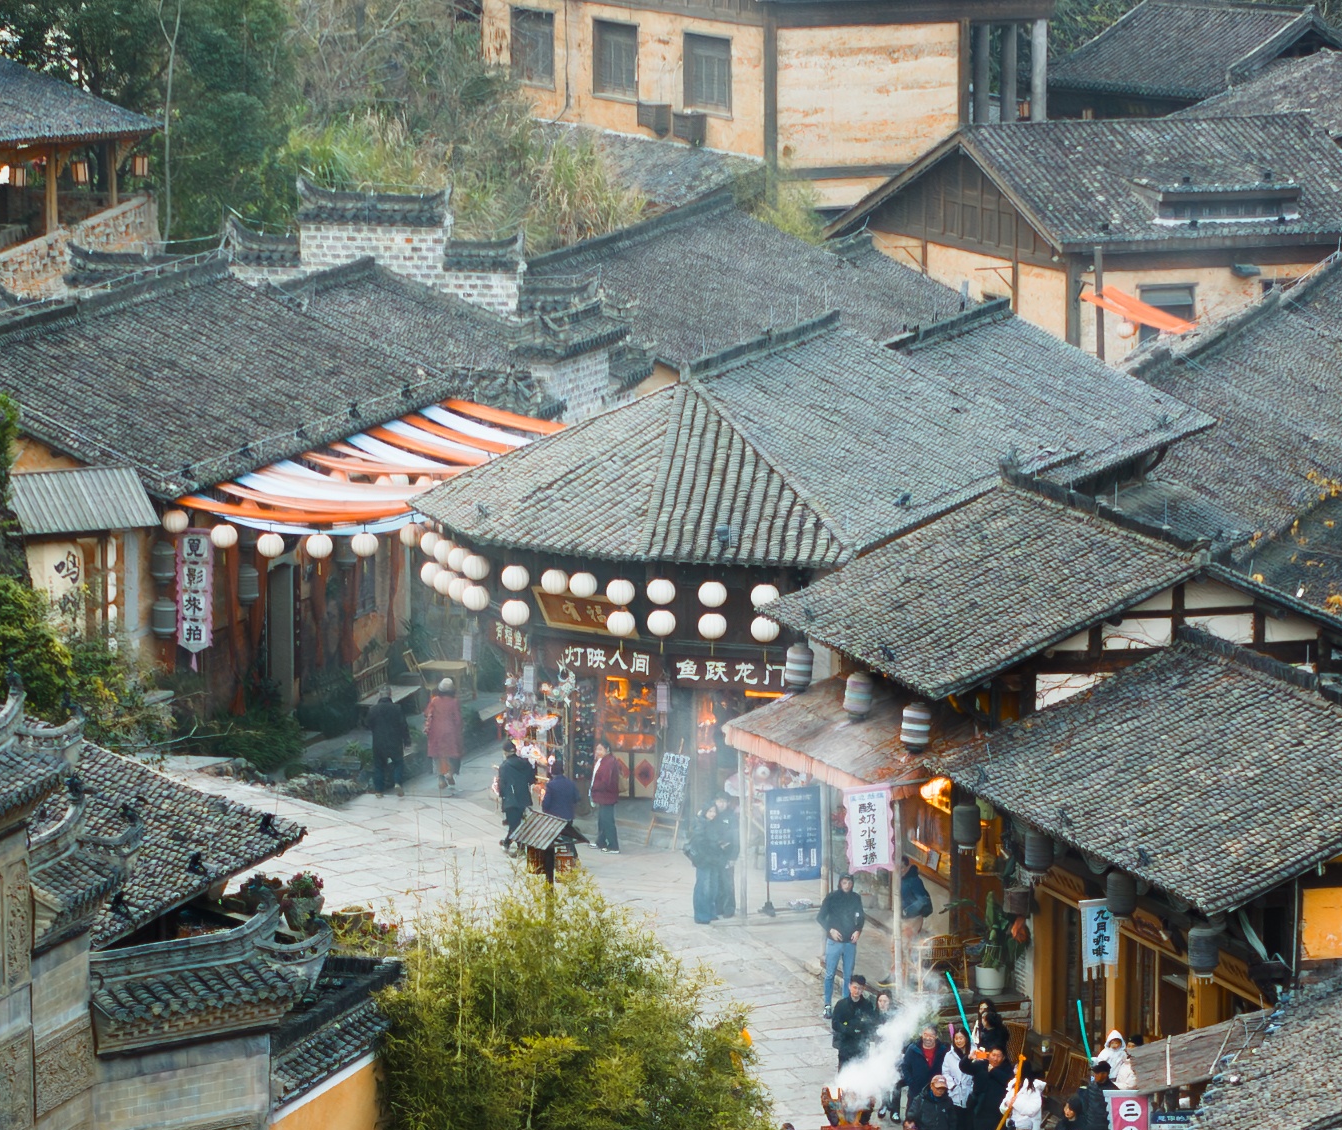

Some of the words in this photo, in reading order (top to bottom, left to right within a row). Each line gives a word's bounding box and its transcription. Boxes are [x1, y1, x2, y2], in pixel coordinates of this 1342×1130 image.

[564, 646, 650, 676] 灯映人间
[676, 659, 786, 687] 鱼跃龙门
[858, 802, 877, 865] 酸奶水果捞
